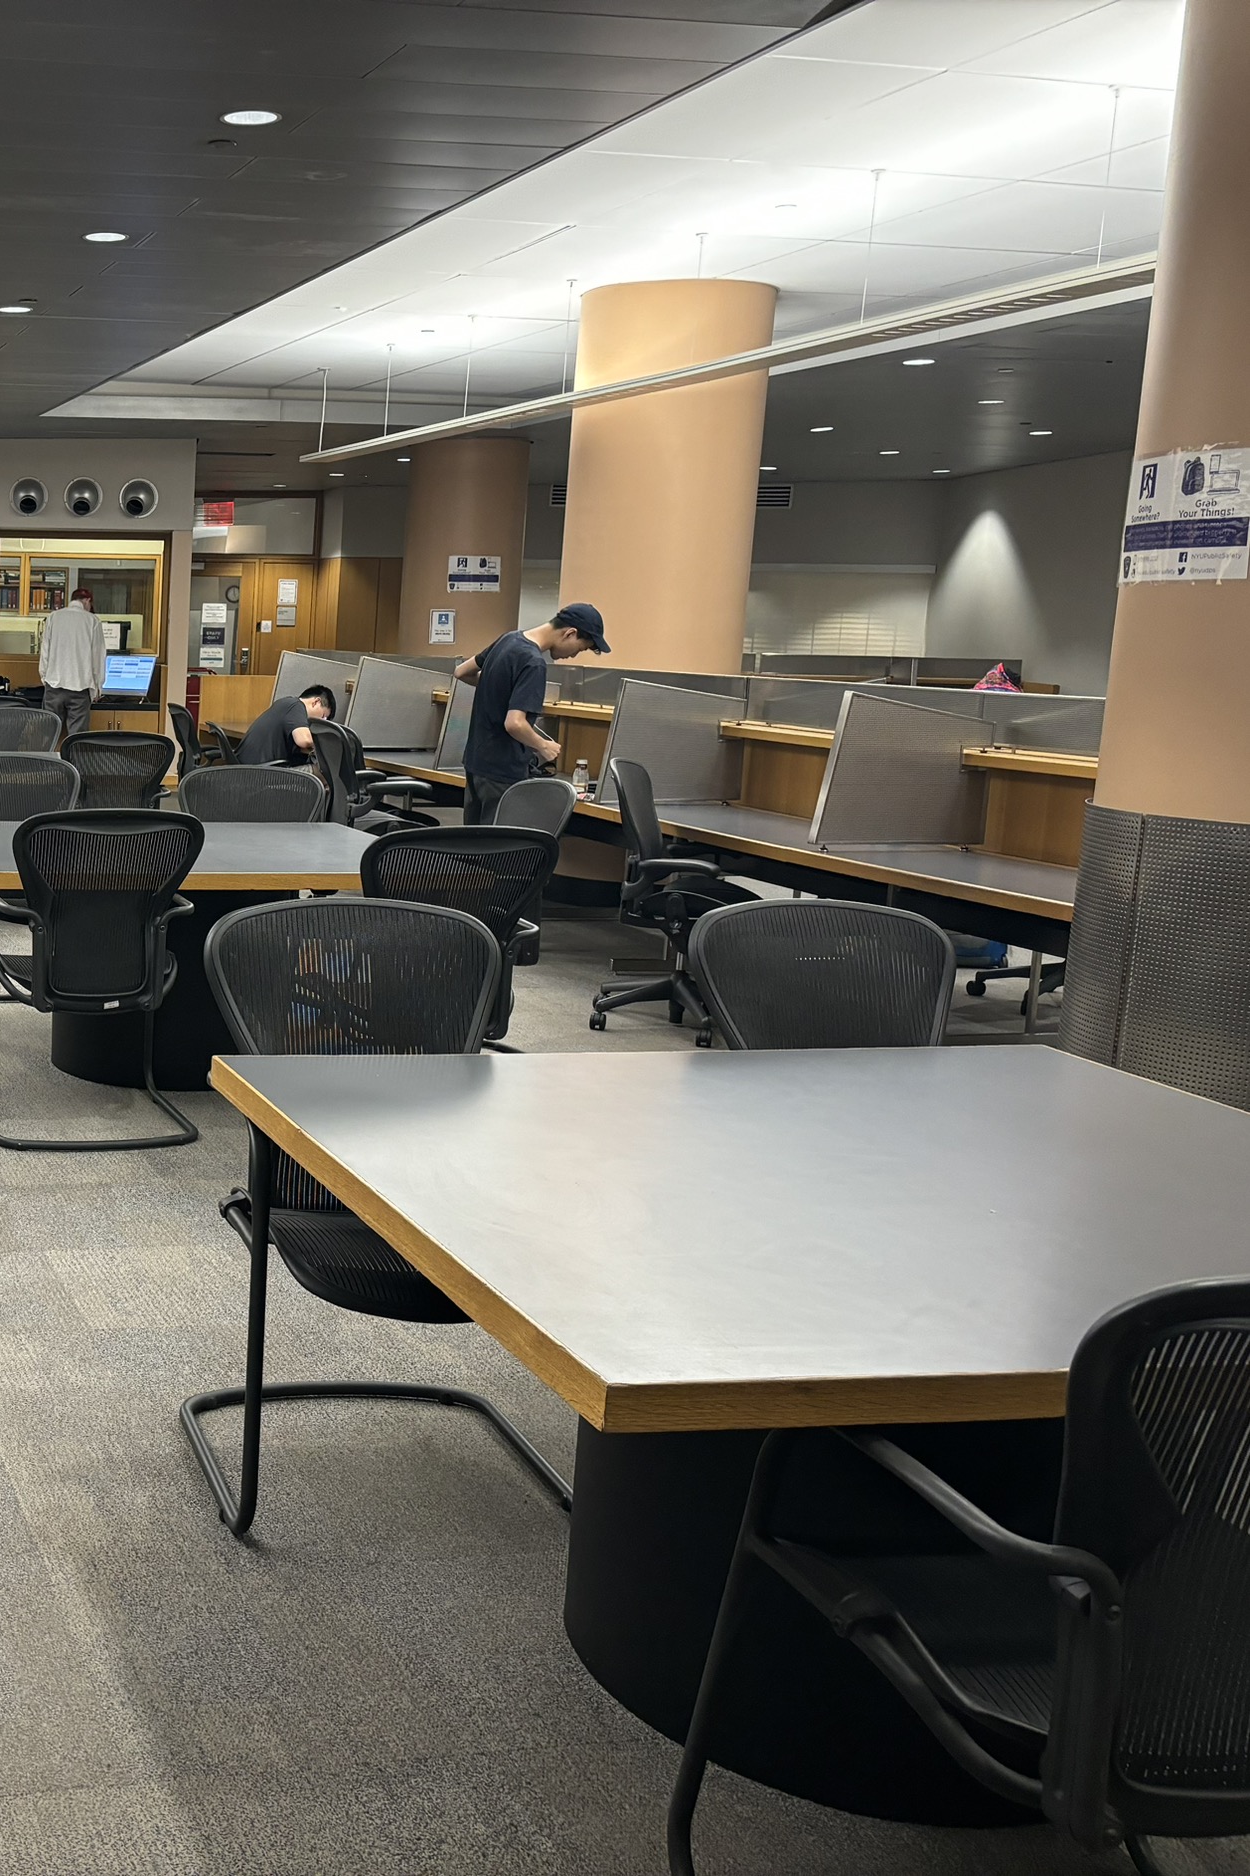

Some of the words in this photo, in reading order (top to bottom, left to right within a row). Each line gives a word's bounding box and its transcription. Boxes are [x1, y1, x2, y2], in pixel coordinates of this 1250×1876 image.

[1195, 498, 1218, 508] Grab
[1138, 504, 1153, 514] Going
[1178, 510, 1198, 519] Your
[1200, 507, 1235, 519] Things!
[1131, 512, 1161, 523] Somewhere?
